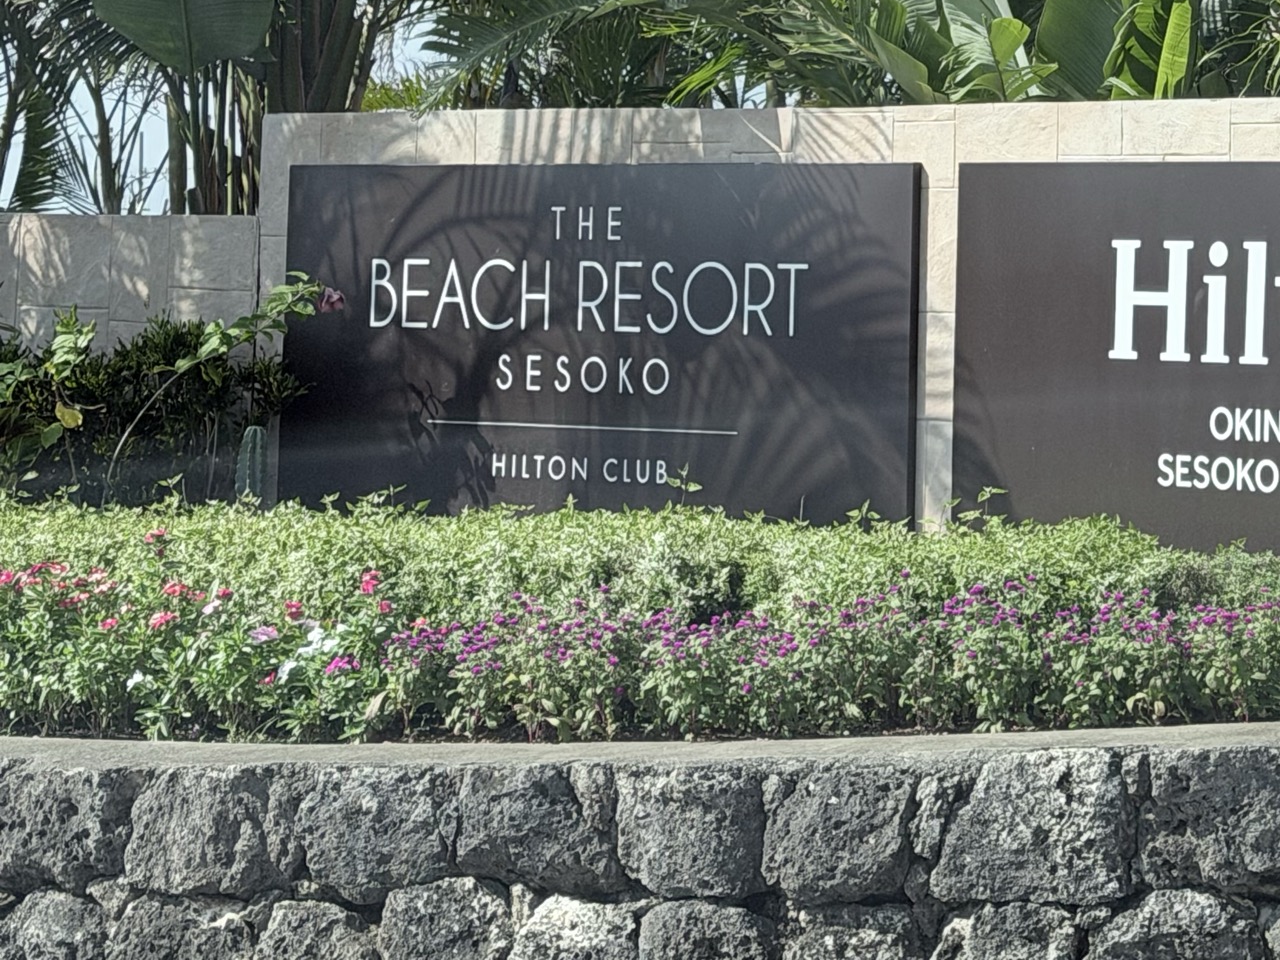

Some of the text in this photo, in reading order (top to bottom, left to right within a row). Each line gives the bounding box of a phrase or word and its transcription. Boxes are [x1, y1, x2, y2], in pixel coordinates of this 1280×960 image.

[550, 206, 622, 241] THE
[368, 258, 809, 337] BEACH RESORT
[495, 354, 670, 395] SESOKO
[491, 452, 668, 484] HILTON CLUB
[1156, 453, 1280, 494] SESOKO
